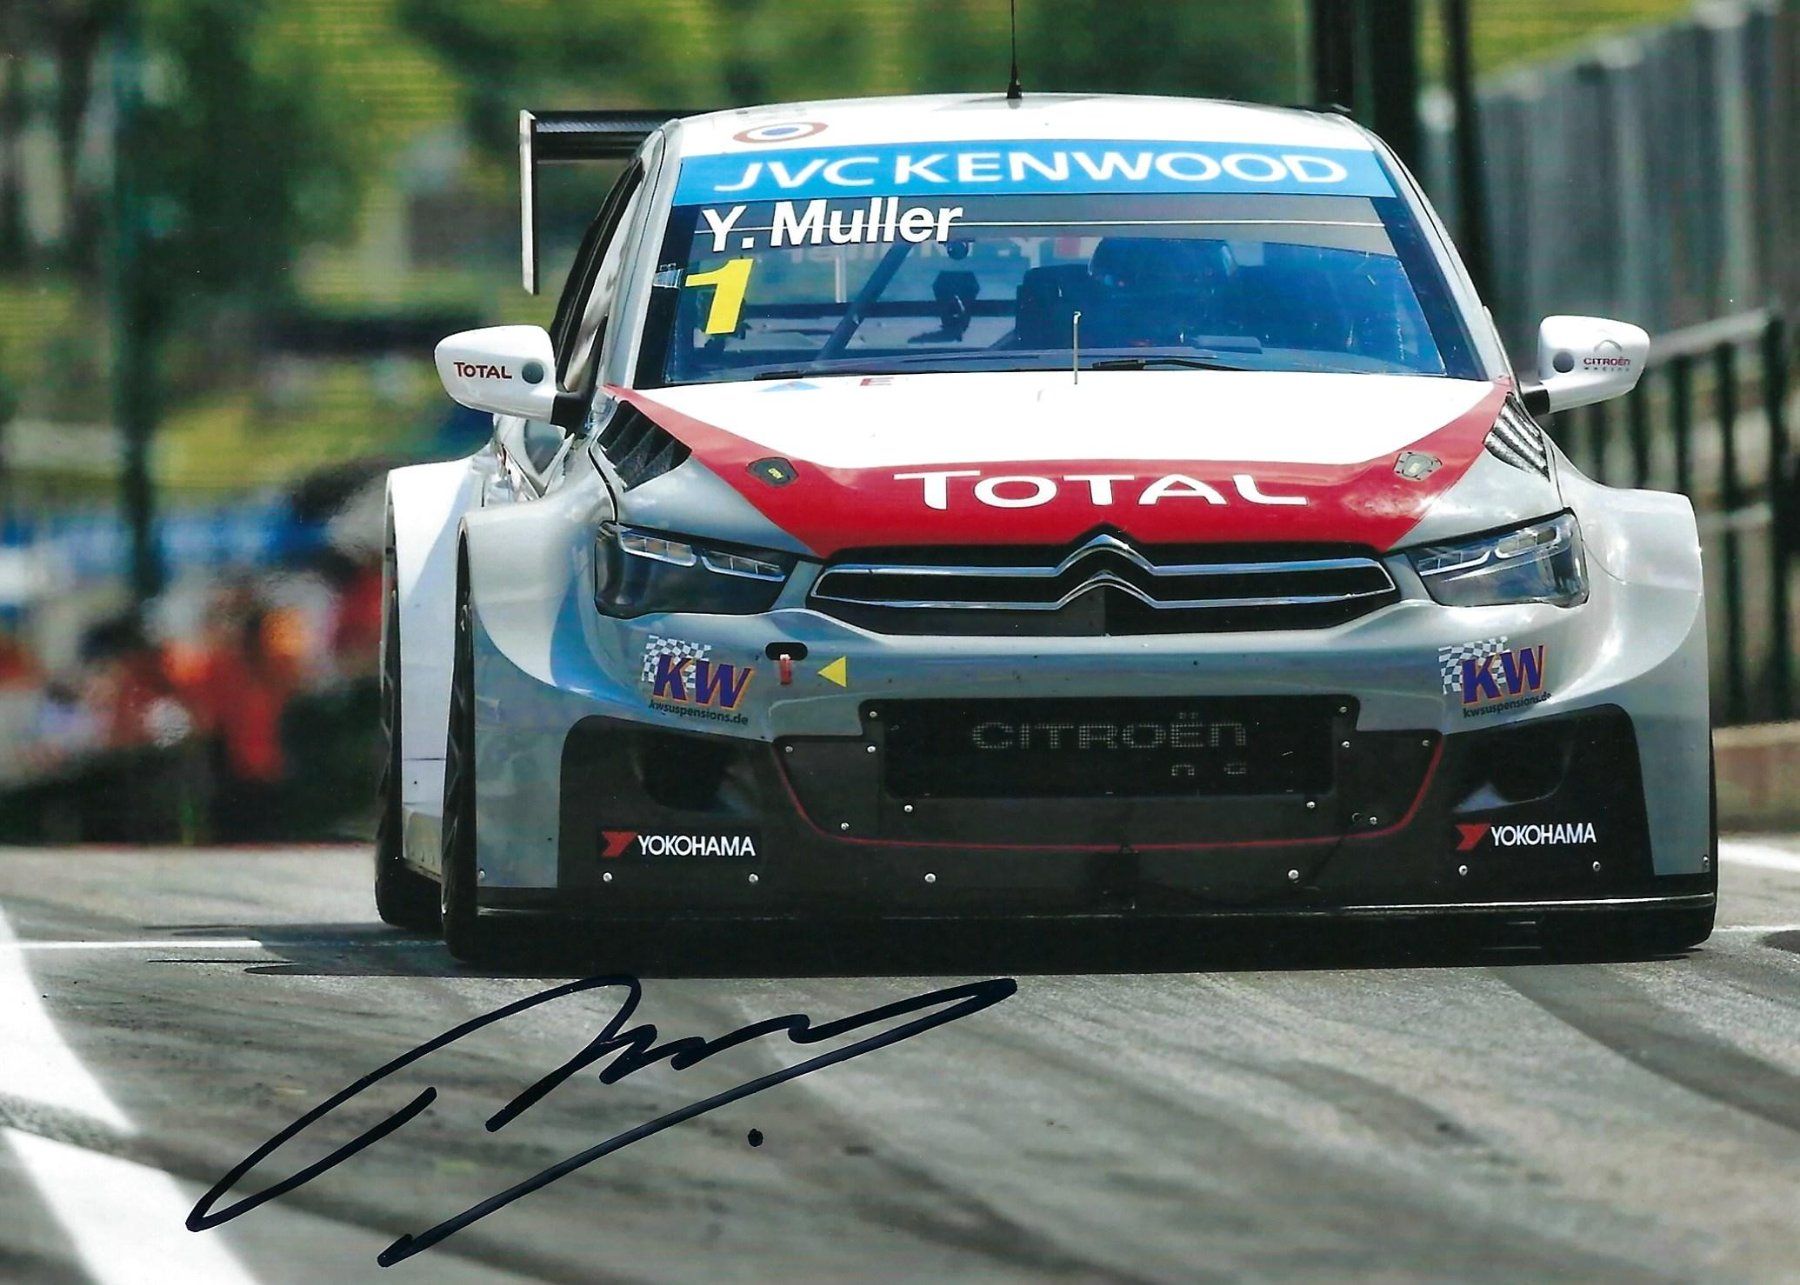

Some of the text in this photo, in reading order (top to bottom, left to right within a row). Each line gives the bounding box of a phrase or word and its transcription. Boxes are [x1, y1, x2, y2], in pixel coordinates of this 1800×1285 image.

[702, 205, 755, 252] Y.
[771, 196, 962, 248] Muller
[685, 258, 754, 335] 1
[453, 361, 512, 379] TOTAL
[893, 471, 1308, 510] TOTAL
[653, 653, 753, 710] KW
[1461, 645, 1545, 705] KW
[648, 699, 749, 726] kwsuspensions.de
[1463, 691, 1552, 719] kwsuspensions.de
[637, 834, 756, 857] YOKOHAMA
[1490, 822, 1597, 847] YOKOHAMA
